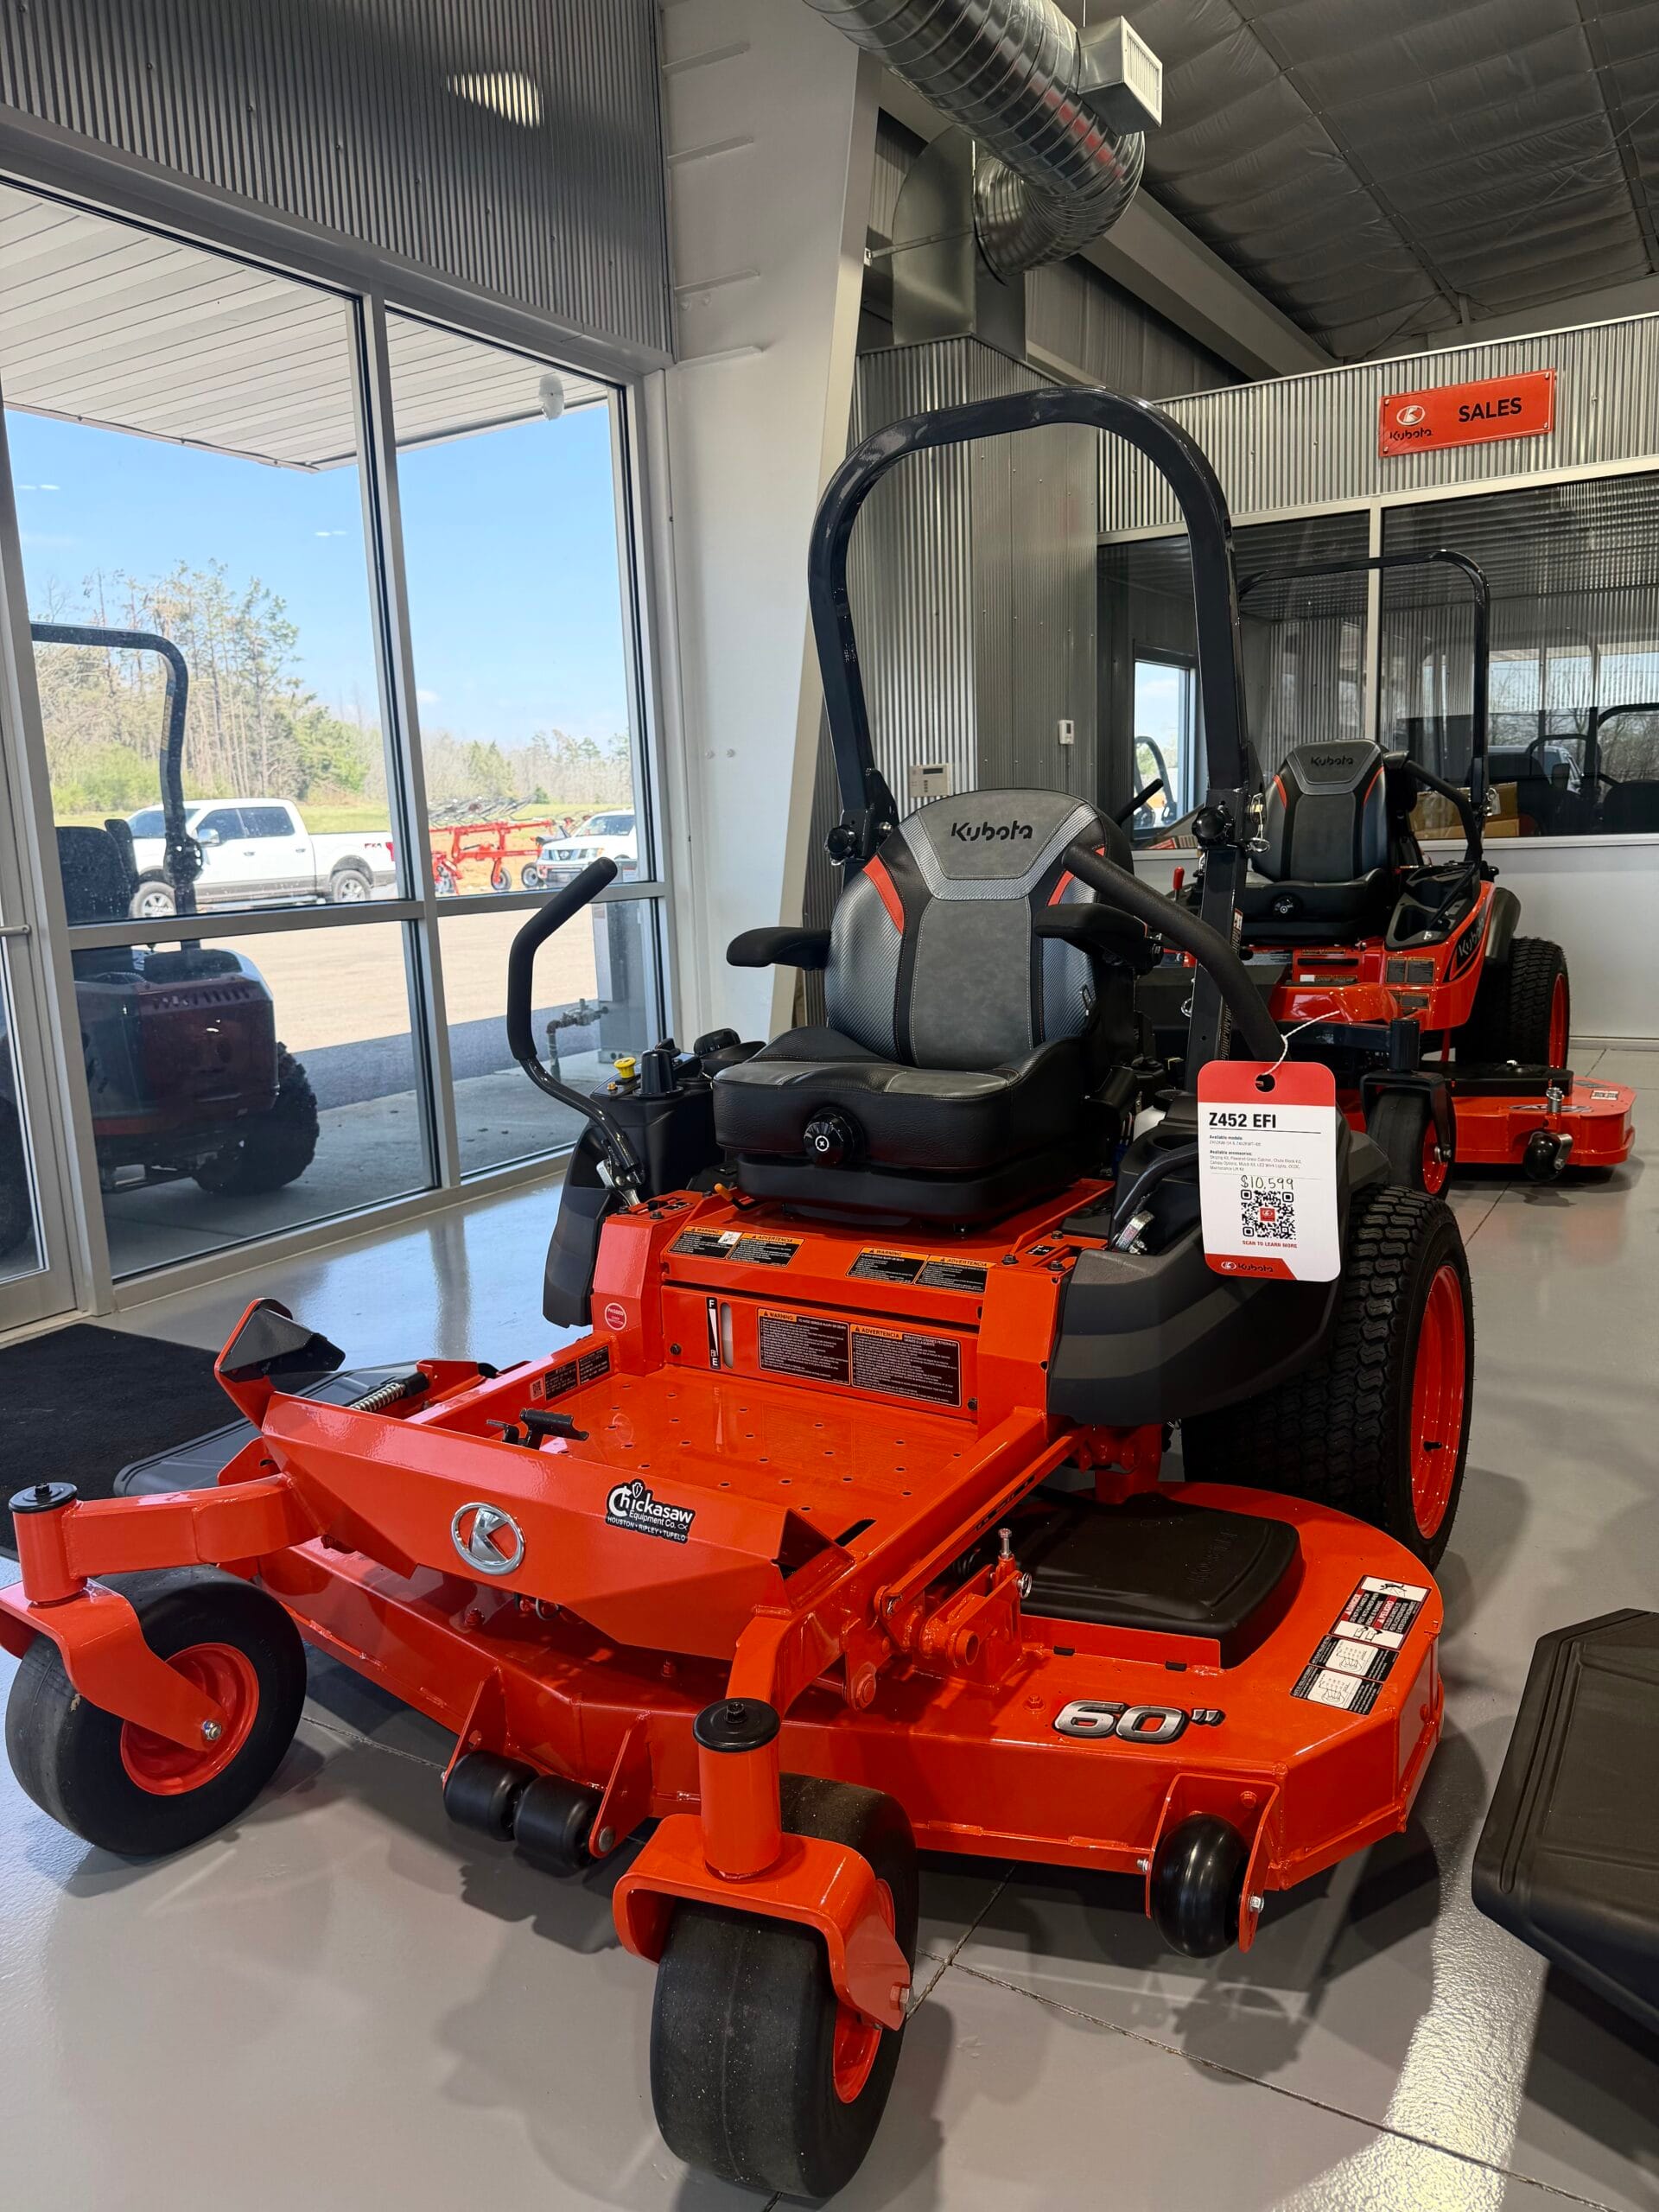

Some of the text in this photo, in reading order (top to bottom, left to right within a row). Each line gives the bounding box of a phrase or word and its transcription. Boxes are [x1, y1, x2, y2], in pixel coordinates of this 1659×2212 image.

[1459, 397, 1522, 423] SALES
[1389, 427, 1433, 441] Kubota
[1310, 755, 1354, 767] Kubota
[950, 820, 1033, 842] Kubota
[1210, 1112, 1276, 1128] Z452 EFI
[1238, 1263, 1274, 1272] Kubota
[709, 1300, 715, 1308] F
[769, 1312, 793, 1321] WARNING
[861, 1327, 899, 1338] ADVERTENCIA
[712, 1357, 718, 1366] E
[609, 1485, 693, 1524] Chickasaw
[629, 1510, 677, 1529] Equipment Co.
[607, 1516, 686, 1541] HOUSTON RIPLEY TUPELO
[1052, 1698, 1225, 1745] 60"
